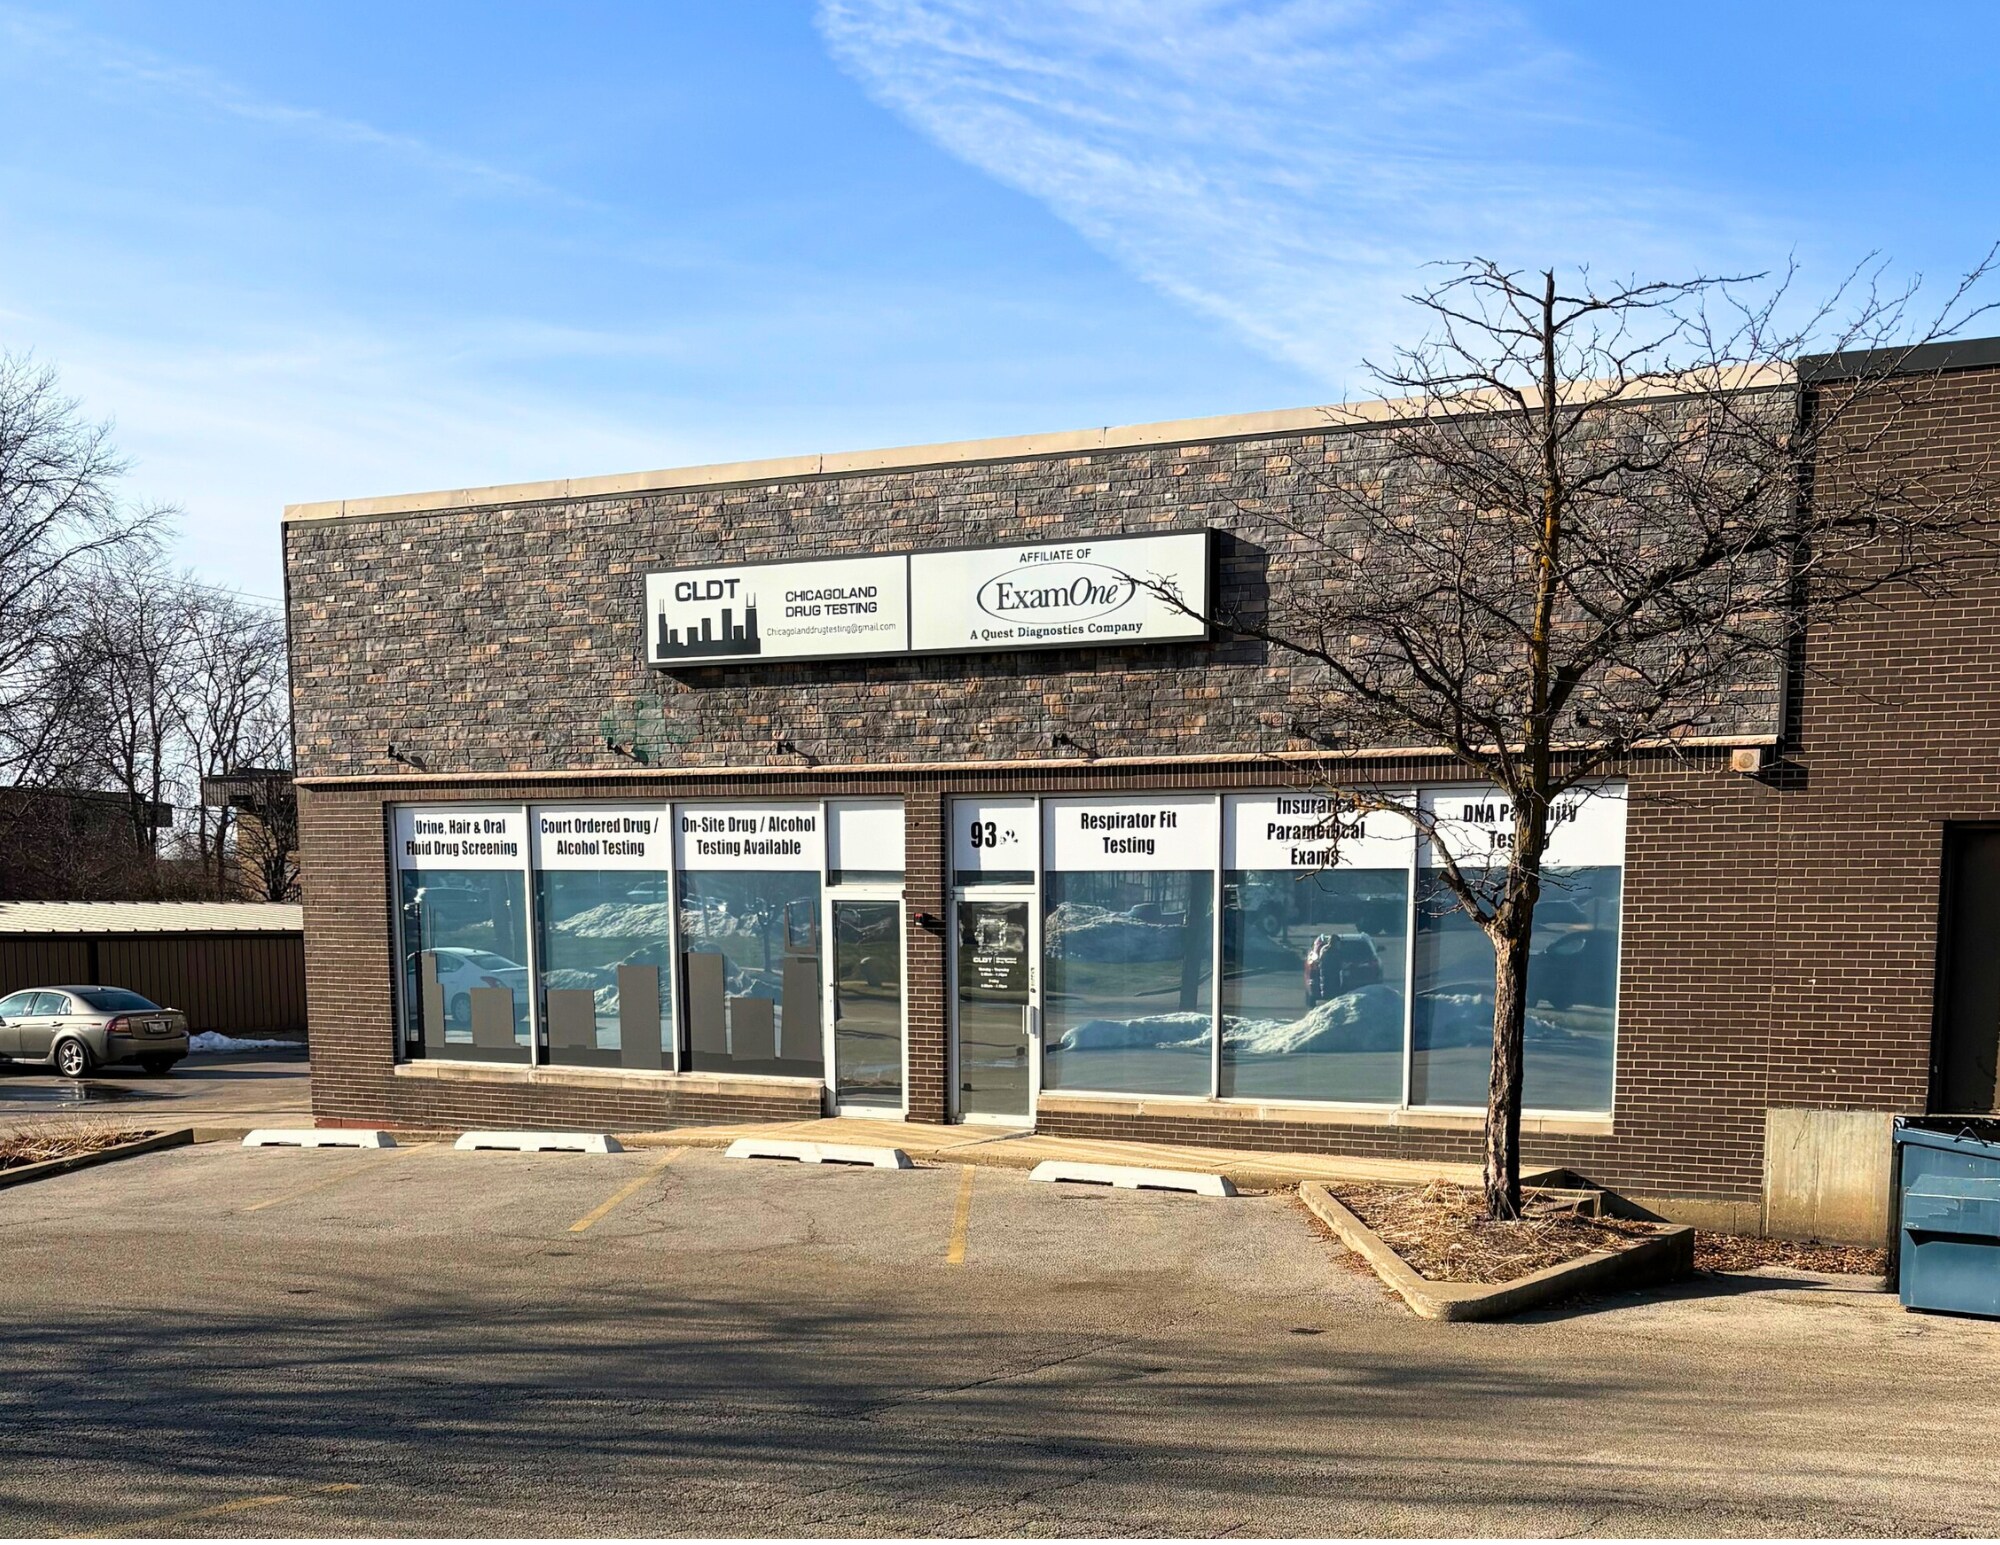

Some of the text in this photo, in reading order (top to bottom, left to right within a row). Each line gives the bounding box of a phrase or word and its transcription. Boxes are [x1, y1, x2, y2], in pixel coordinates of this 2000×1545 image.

[1019, 548, 1092, 563] AFFILIATE OF
[674, 578, 741, 602] CLDT
[785, 586, 878, 602] CHICAGOLAND
[996, 576, 1119, 610] ExamOne
[785, 601, 878, 618] DRUG TESTING
[766, 623, 897, 637] Chicagolanddrugtesting@gmail.com
[970, 622, 1143, 640] A Quest Diagnostics Company
[1080, 810, 1177, 831] Respirator Fit
[1463, 804, 1495, 823] DNA
[415, 818, 506, 836] Urine, Hair & Oral
[541, 818, 572, 834] Court
[574, 817, 621, 833] Ordered
[623, 817, 651, 835] Drug
[681, 816, 725, 833] On-Site
[728, 816, 757, 834] Drug
[768, 815, 816, 832] Alcohol
[406, 840, 518, 857] Fluid Drug Screening
[556, 839, 645, 857] Alcohol Testing
[696, 838, 802, 857] Testing Available
[1102, 836, 1155, 855] Testing
[1291, 848, 1339, 867] Exams
